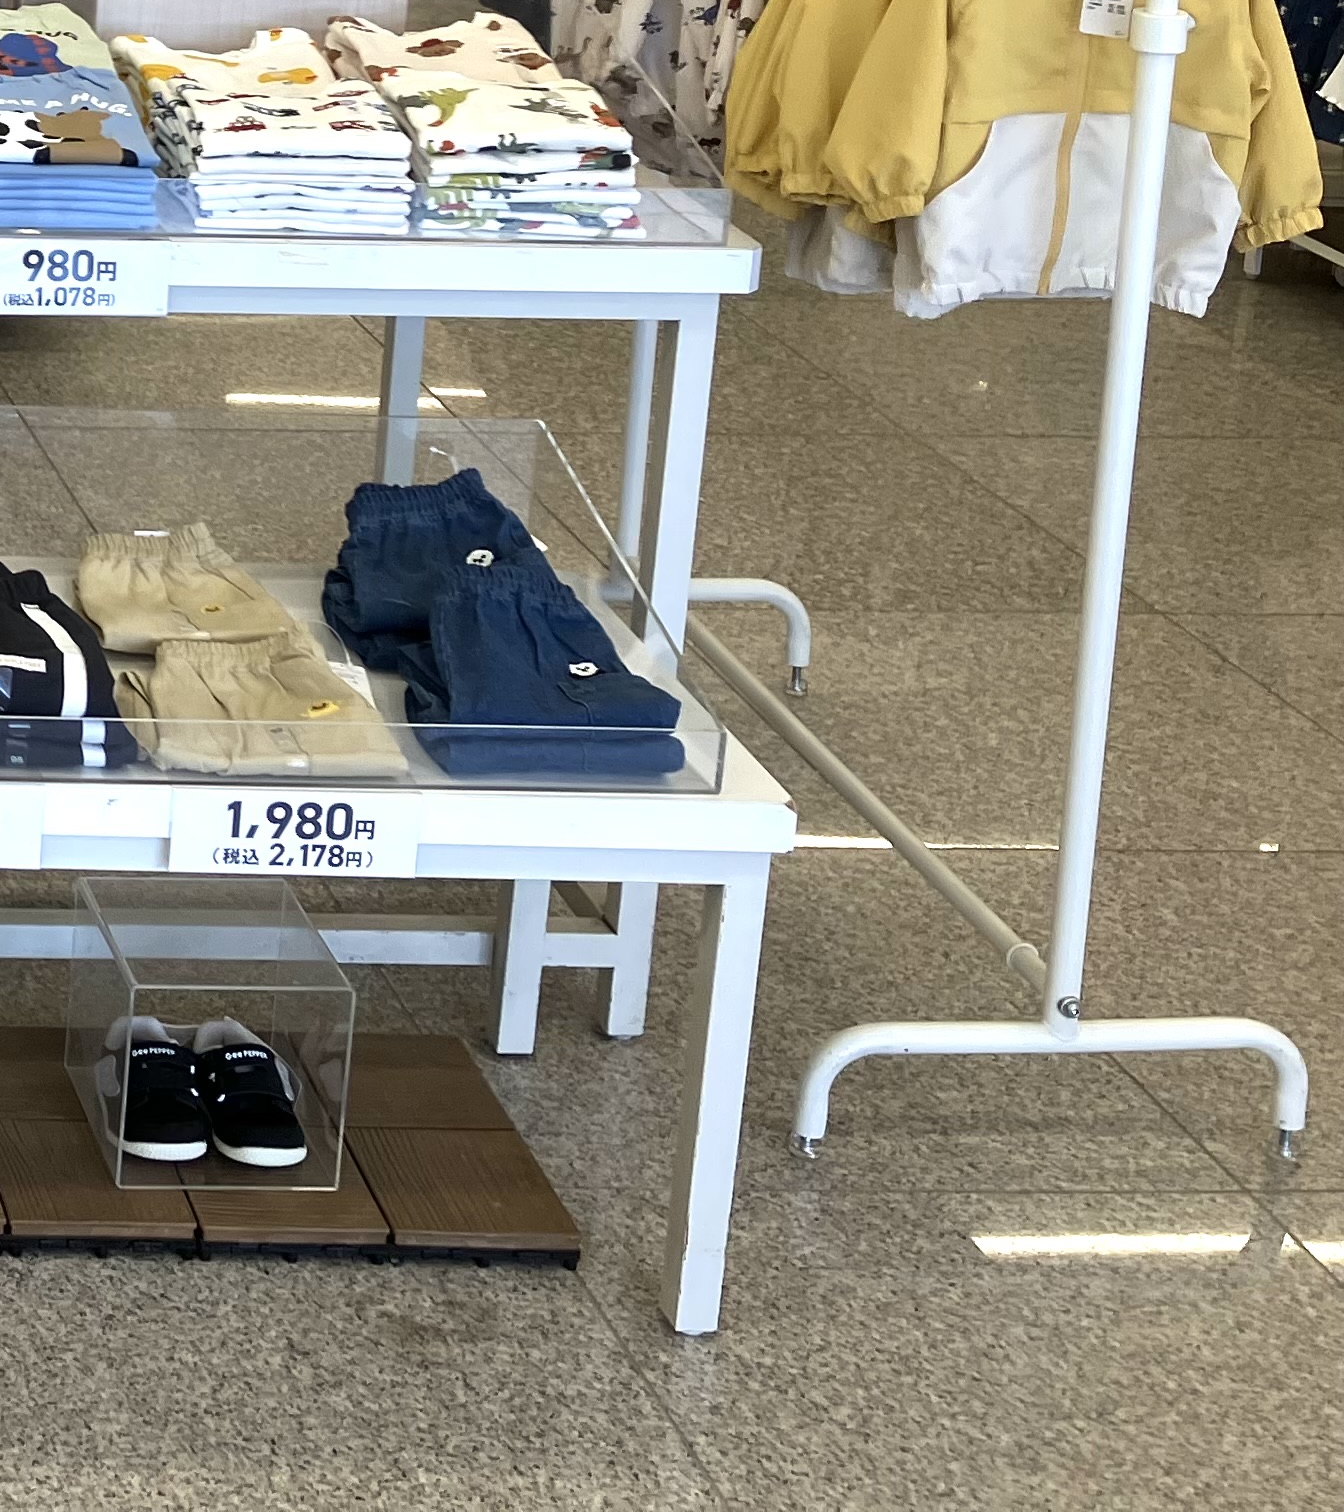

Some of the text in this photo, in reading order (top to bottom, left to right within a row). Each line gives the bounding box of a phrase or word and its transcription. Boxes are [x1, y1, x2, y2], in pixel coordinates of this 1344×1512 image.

[45, 100, 62, 110] A
[23, 249, 117, 282] 980円
[3, 287, 115, 307] (税込1,078円)
[226, 800, 375, 842] 1,980円
